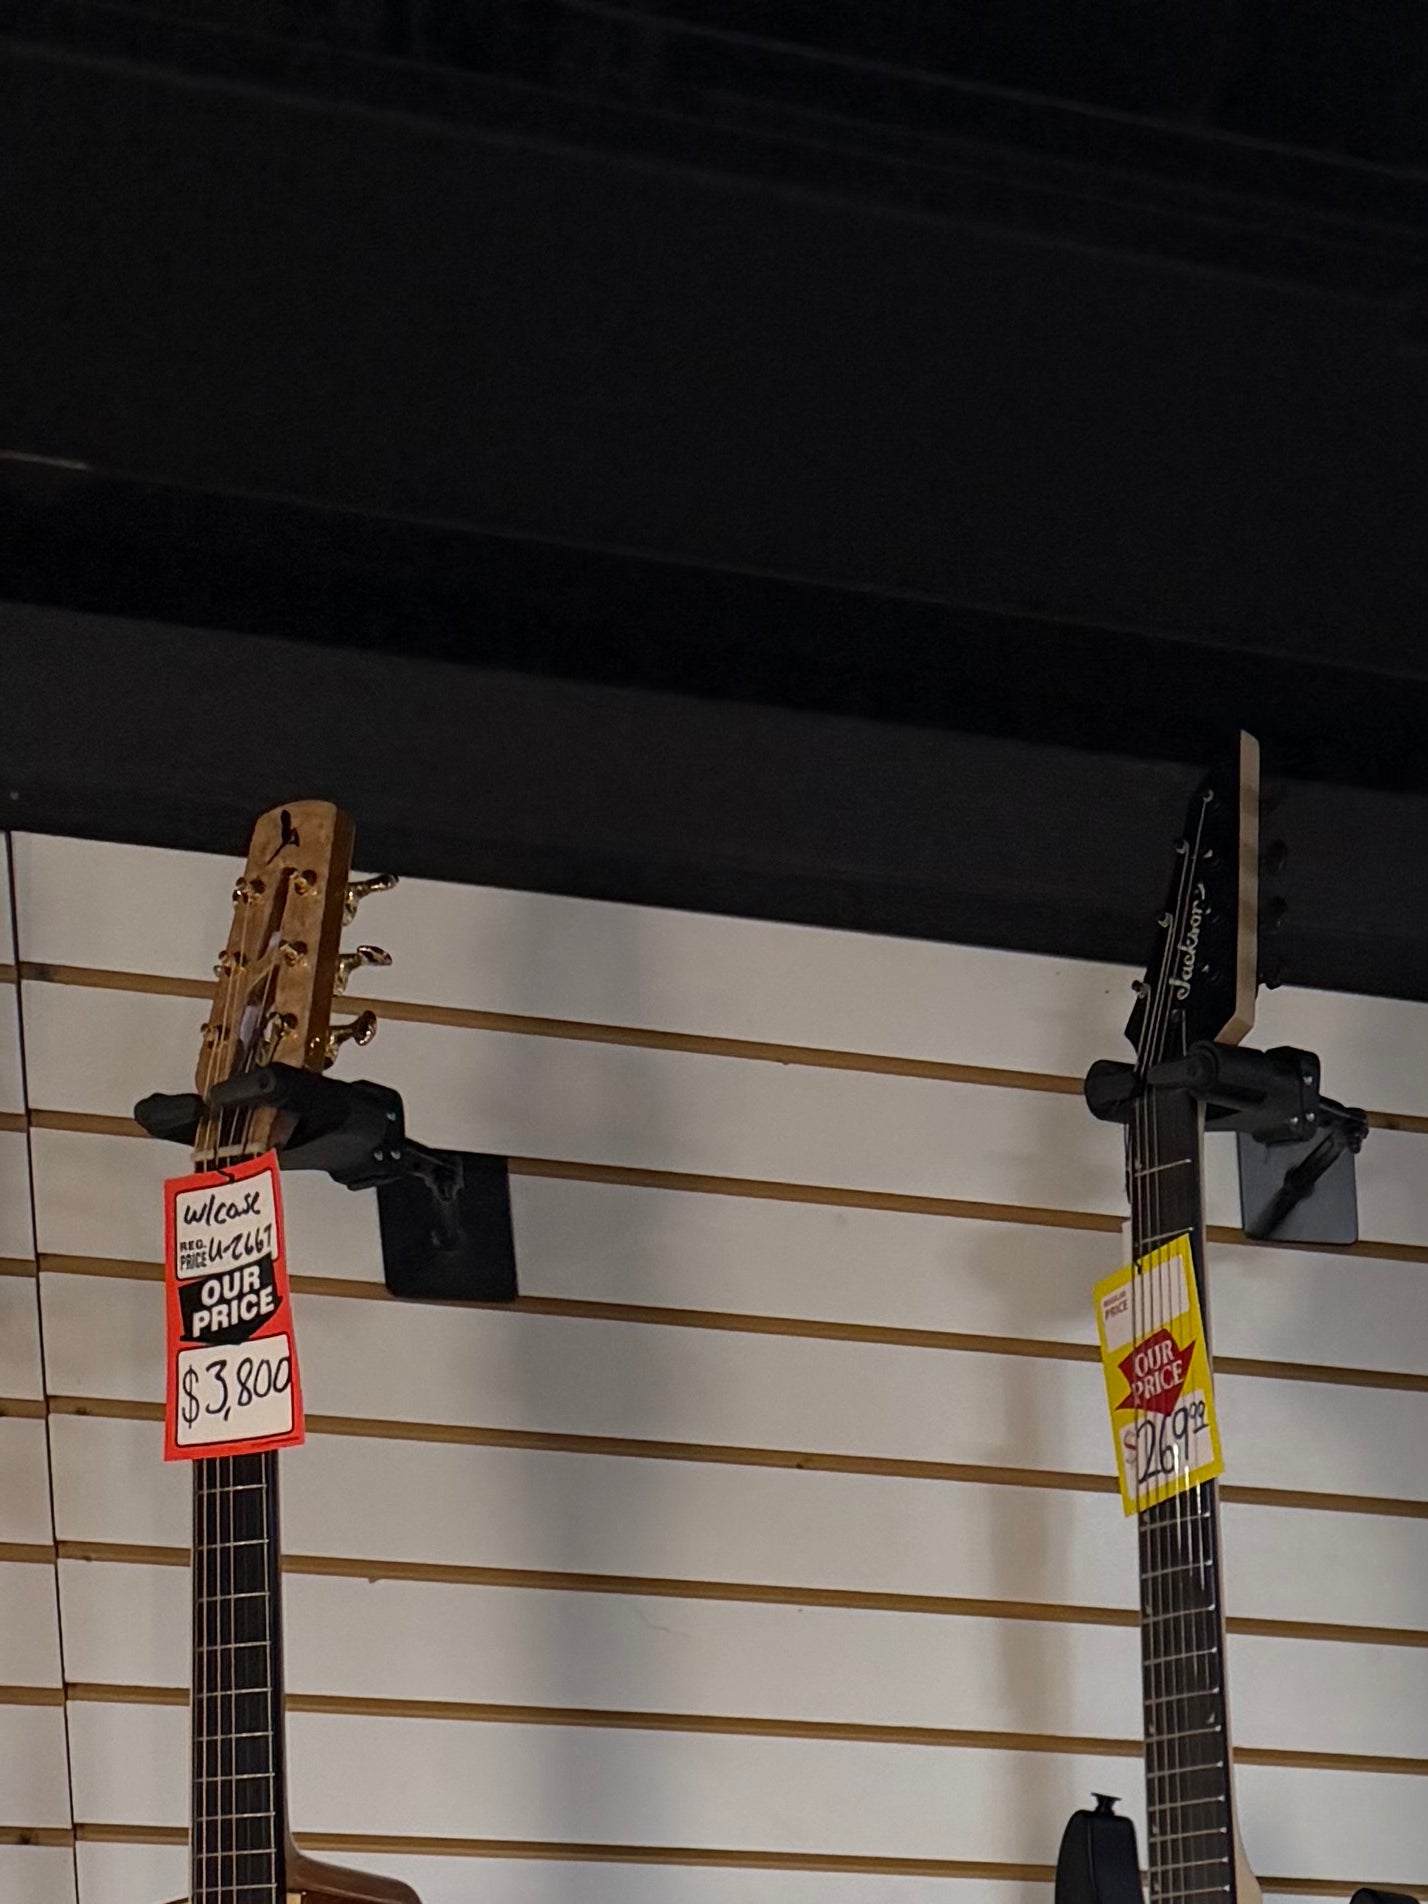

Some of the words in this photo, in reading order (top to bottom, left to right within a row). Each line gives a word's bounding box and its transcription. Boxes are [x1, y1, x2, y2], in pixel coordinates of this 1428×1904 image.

[180, 1252, 207, 1270] PRICE
[201, 1265, 260, 1303] OUR
[193, 1287, 274, 1338] PRICE
[1134, 1340, 1175, 1373] OUR
[182, 1356, 290, 1429] $3,800
[1132, 1361, 1184, 1406] PRICE
